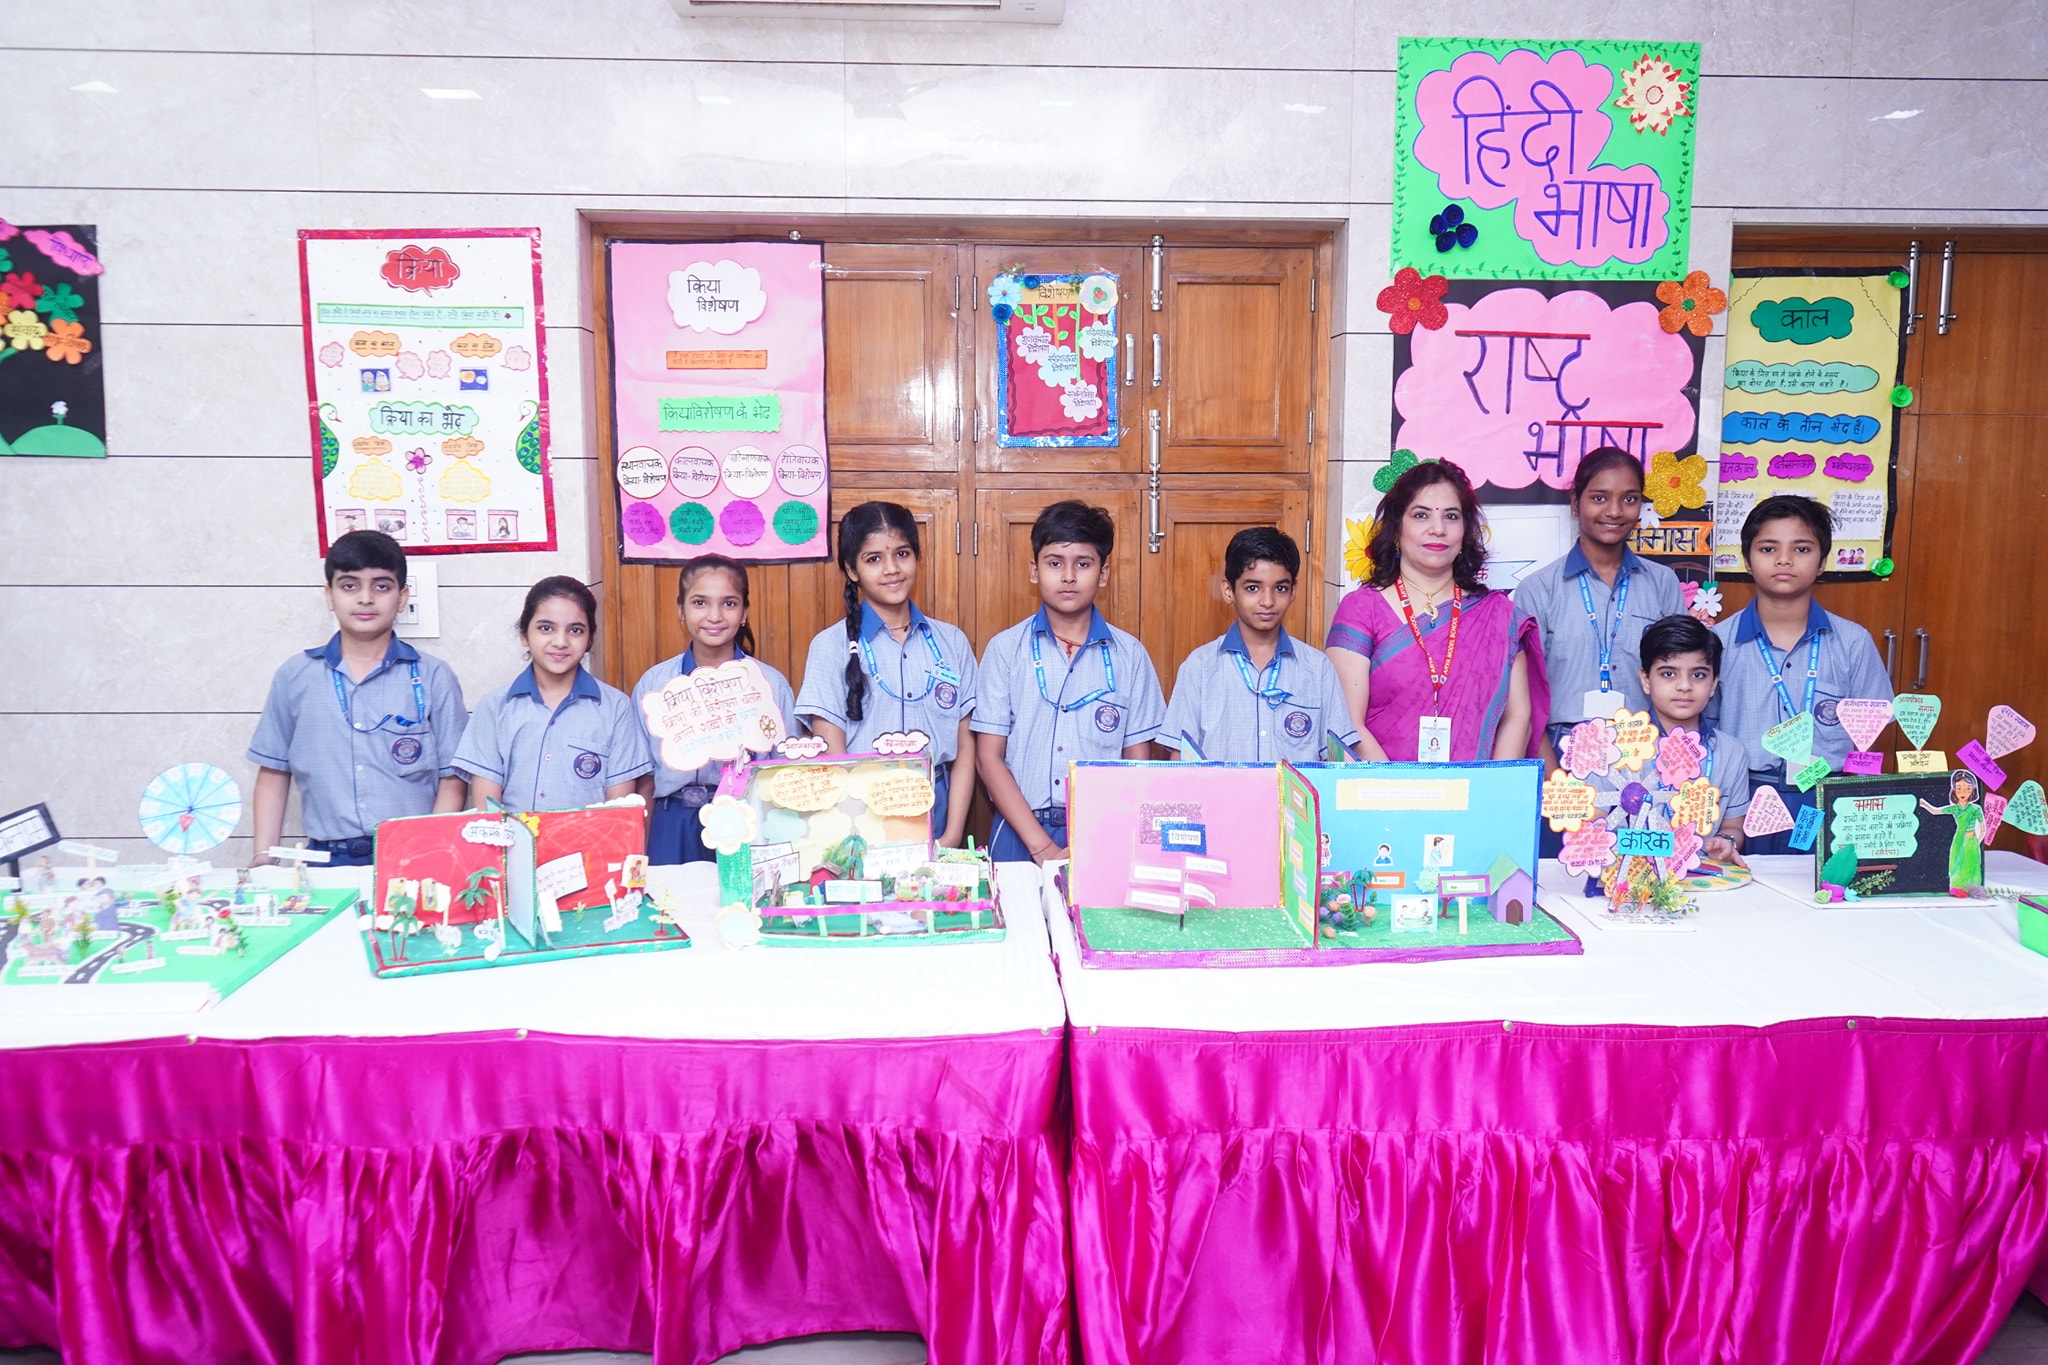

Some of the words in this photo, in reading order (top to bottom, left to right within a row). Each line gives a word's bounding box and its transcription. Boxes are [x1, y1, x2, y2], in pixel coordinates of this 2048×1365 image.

[1452, 75, 1583, 187] हिंदी
[1533, 180, 1654, 250] भाषा
[396, 252, 444, 280] क्रिया
[687, 274, 721, 294] क्रिया
[1038, 284, 1071, 300] विशेषण
[696, 295, 740, 313] विशेषण
[1781, 308, 1830, 330] काल
[380, 405, 414, 426] क्रिया
[417, 411, 433, 427] का
[736, 401, 748, 420] के
[751, 398, 771, 420] भेद
[1741, 415, 1772, 431] काल
[1777, 415, 1790, 432] के
[1799, 415, 1823, 433] तीन
[1830, 417, 1852, 435] भेद
[1450, 616, 1459, 639] SCHOOL
[1447, 639, 1456, 660] MODEL
[1443, 659, 1452, 675] ARYA
[1853, 797, 1887, 812] समास
[1620, 831, 1670, 851] कारक
